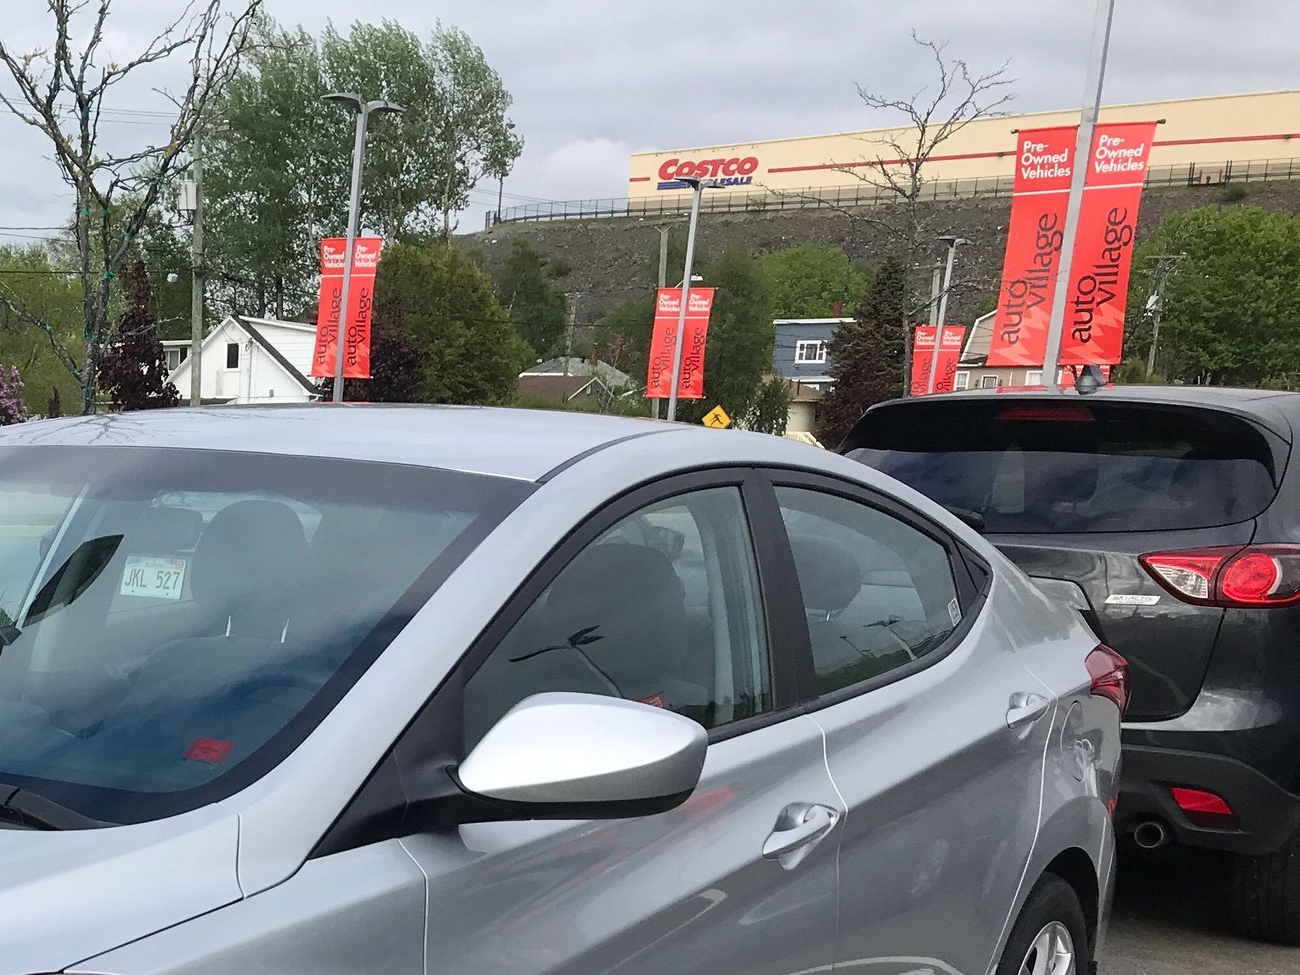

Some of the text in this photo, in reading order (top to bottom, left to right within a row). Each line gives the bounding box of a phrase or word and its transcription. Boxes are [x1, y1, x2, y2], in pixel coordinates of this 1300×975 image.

[1023, 140, 1049, 153] Pre-
[1095, 143, 1144, 160] Owned
[1098, 134, 1126, 147] Pre-
[658, 156, 760, 181] COSTCO
[1021, 148, 1069, 166] Owned
[1094, 157, 1144, 174] Vehicles
[1021, 163, 1071, 180] Vehicles
[323, 245, 336, 254] Pre-
[323, 251, 345, 260] Owned
[355, 250, 376, 260] Owned
[356, 244, 369, 254] Pre-
[1094, 207, 1132, 307] village
[1025, 213, 1064, 310] village
[355, 287, 371, 345] village
[1001, 278, 1028, 345] auto
[1072, 275, 1097, 344] auto
[316, 326, 329, 365] auto
[345, 326, 357, 366] auto
[690, 327, 705, 373] village
[651, 356, 662, 388] auto
[681, 357, 692, 389] auto
[124, 568, 180, 590] JKL 527
